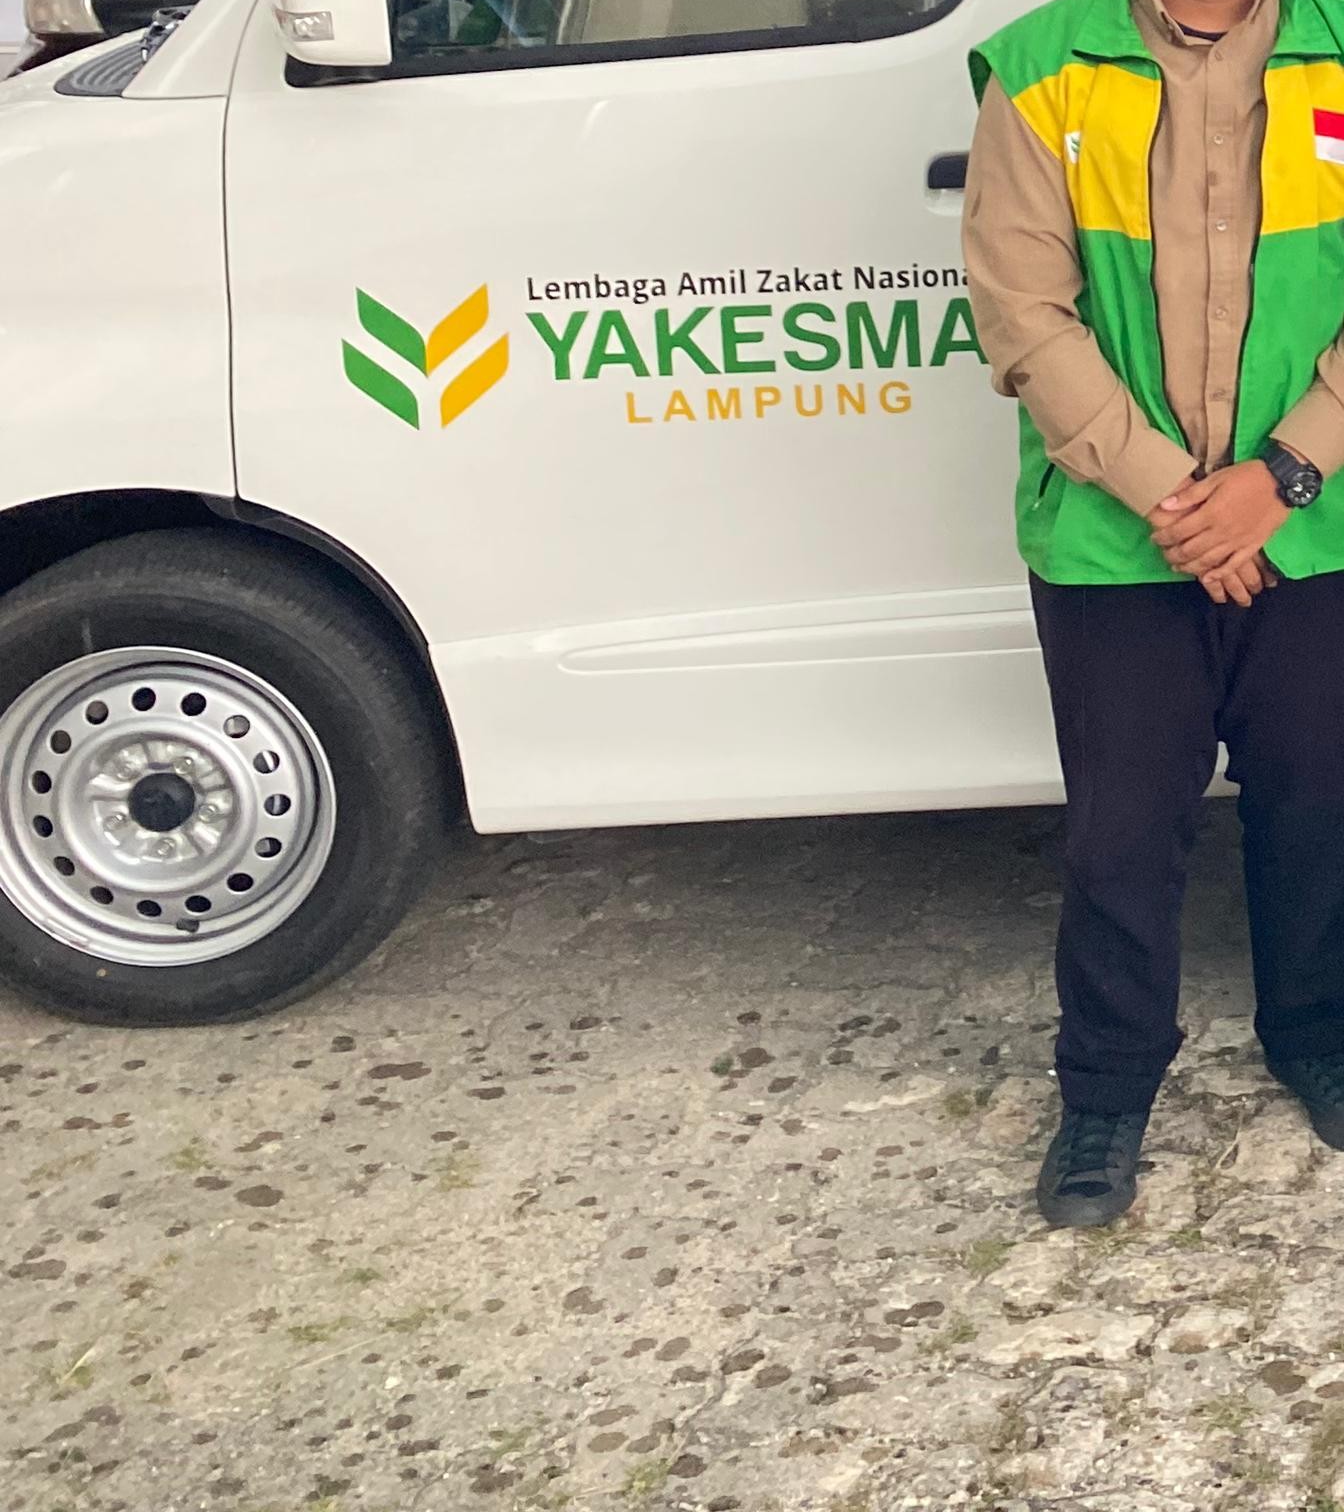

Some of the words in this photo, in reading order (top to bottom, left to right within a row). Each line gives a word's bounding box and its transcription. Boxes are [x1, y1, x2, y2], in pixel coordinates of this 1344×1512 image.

[527, 273, 667, 305] Lembaga
[677, 268, 747, 296] Amil
[756, 267, 844, 294] Zakat
[525, 297, 990, 380] YAKESMA
[626, 380, 913, 424] LAMPUNG
